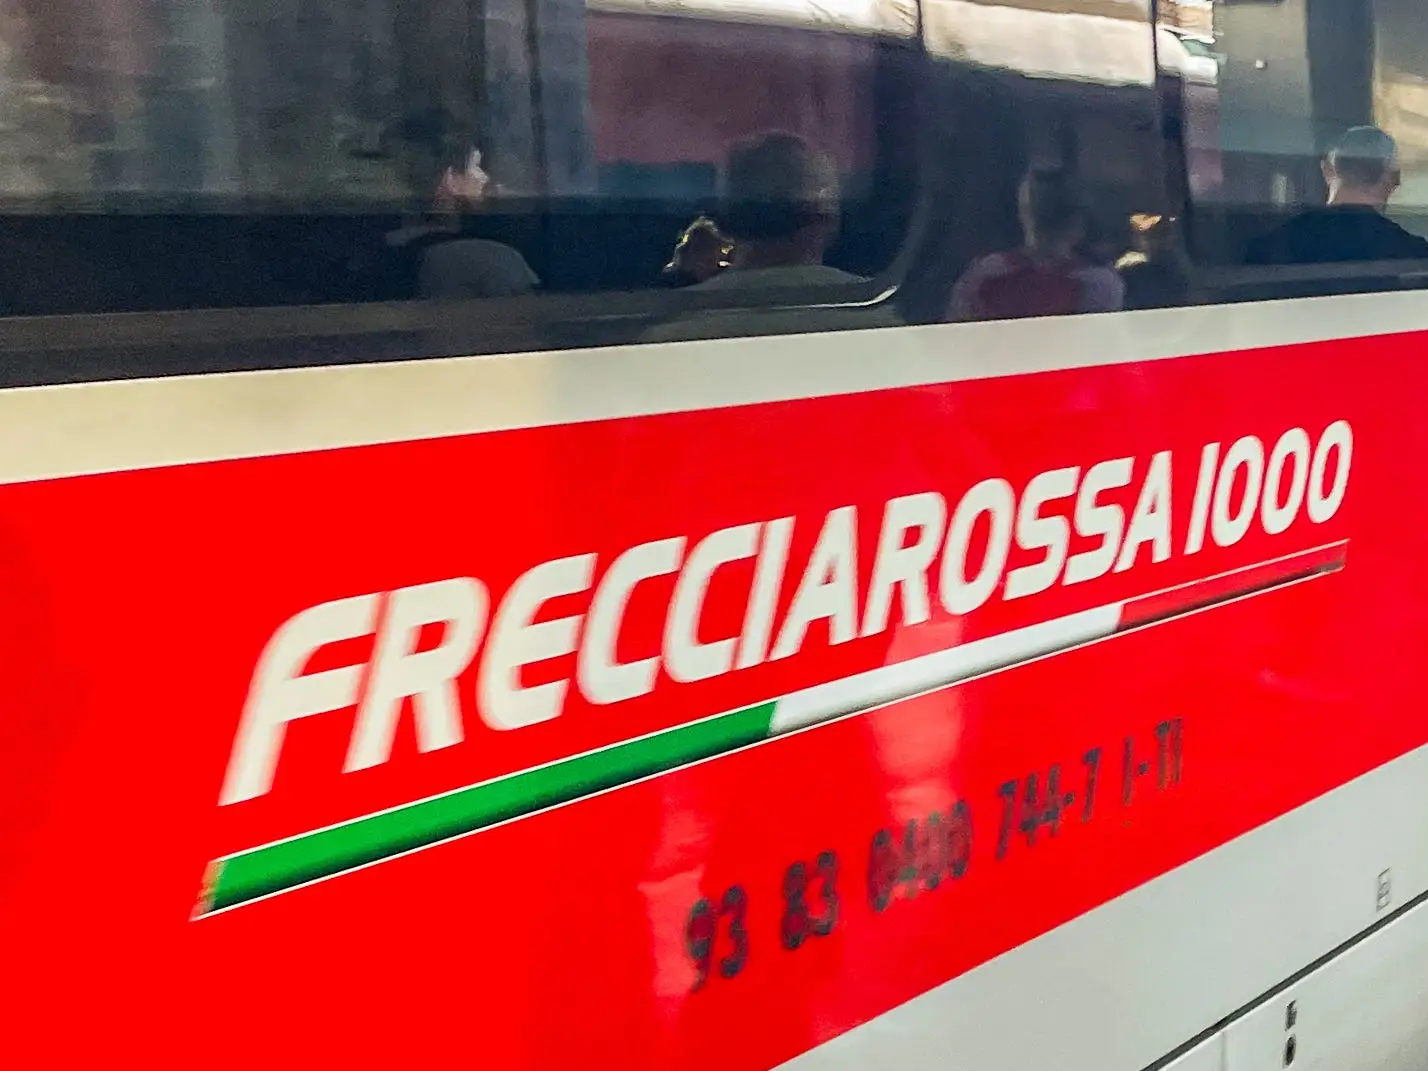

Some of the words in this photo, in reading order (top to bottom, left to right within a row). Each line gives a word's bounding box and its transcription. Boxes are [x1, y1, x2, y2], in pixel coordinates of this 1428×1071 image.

[218, 448, 1174, 807] FRECCIAROSSA
[1184, 419, 1354, 555] 1000
[685, 884, 750, 994] 93
[780, 849, 840, 952] 83
